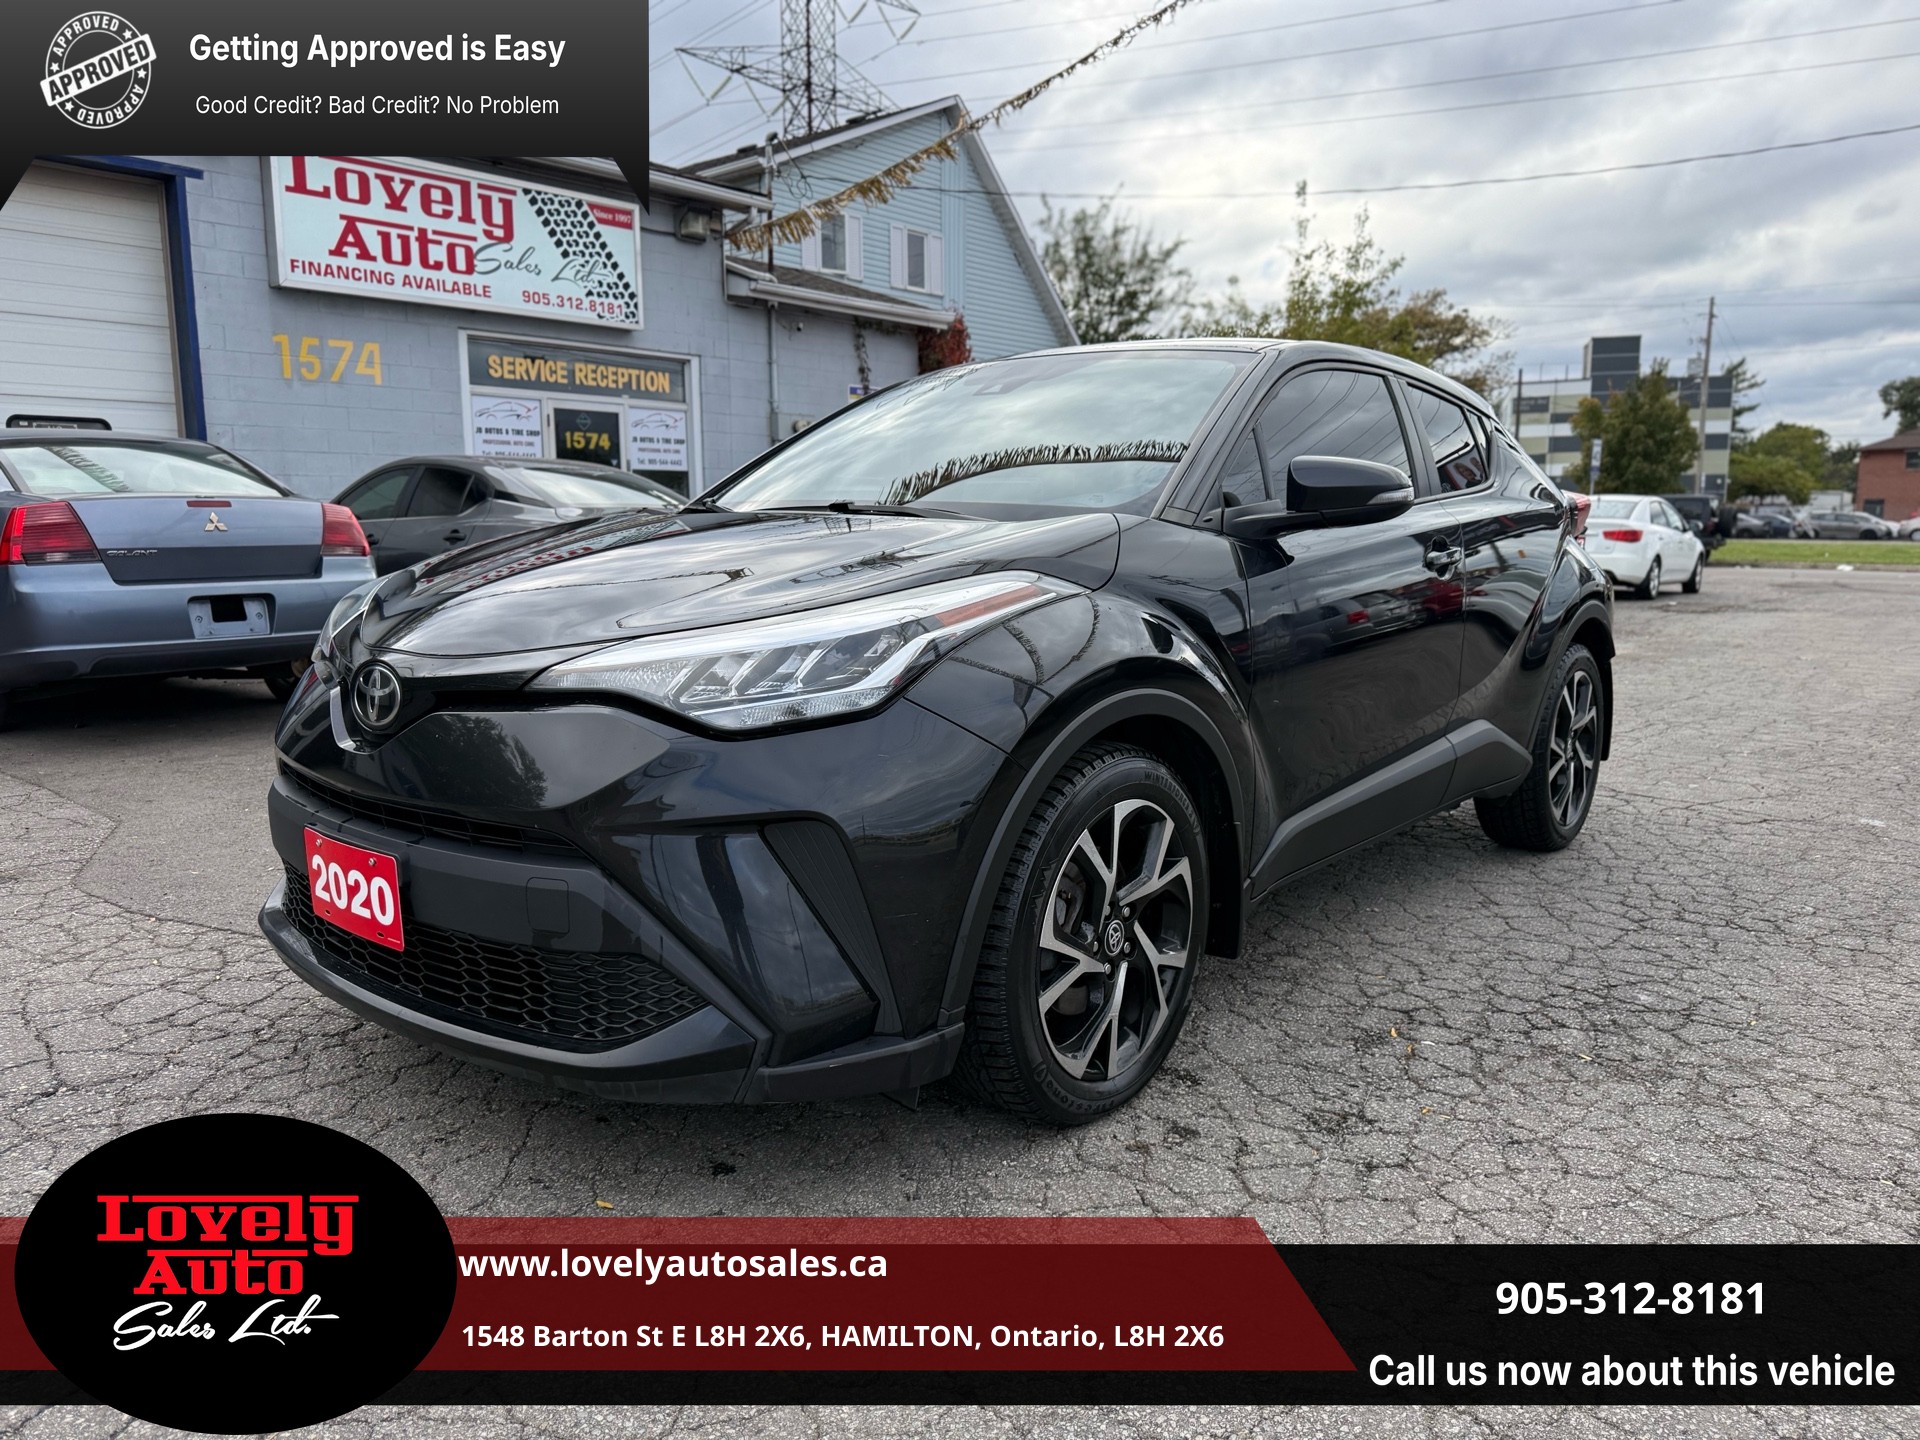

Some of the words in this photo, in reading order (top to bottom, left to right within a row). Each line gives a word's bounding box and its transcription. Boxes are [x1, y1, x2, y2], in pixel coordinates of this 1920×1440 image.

[285, 156, 517, 243] Lovely
[328, 214, 478, 276] Auto
[473, 240, 542, 276] Sales
[290, 258, 395, 286] FINANCING
[402, 275, 492, 298] AVAILABLE
[522, 290, 622, 317] 905.312.8181
[272, 333, 383, 386] 1574
[487, 354, 569, 384] SERVICE
[574, 361, 671, 394] RECEPTION
[526, 429, 540, 437] SHOP
[565, 431, 611, 450] 1574
[312, 854, 395, 926] 2020
